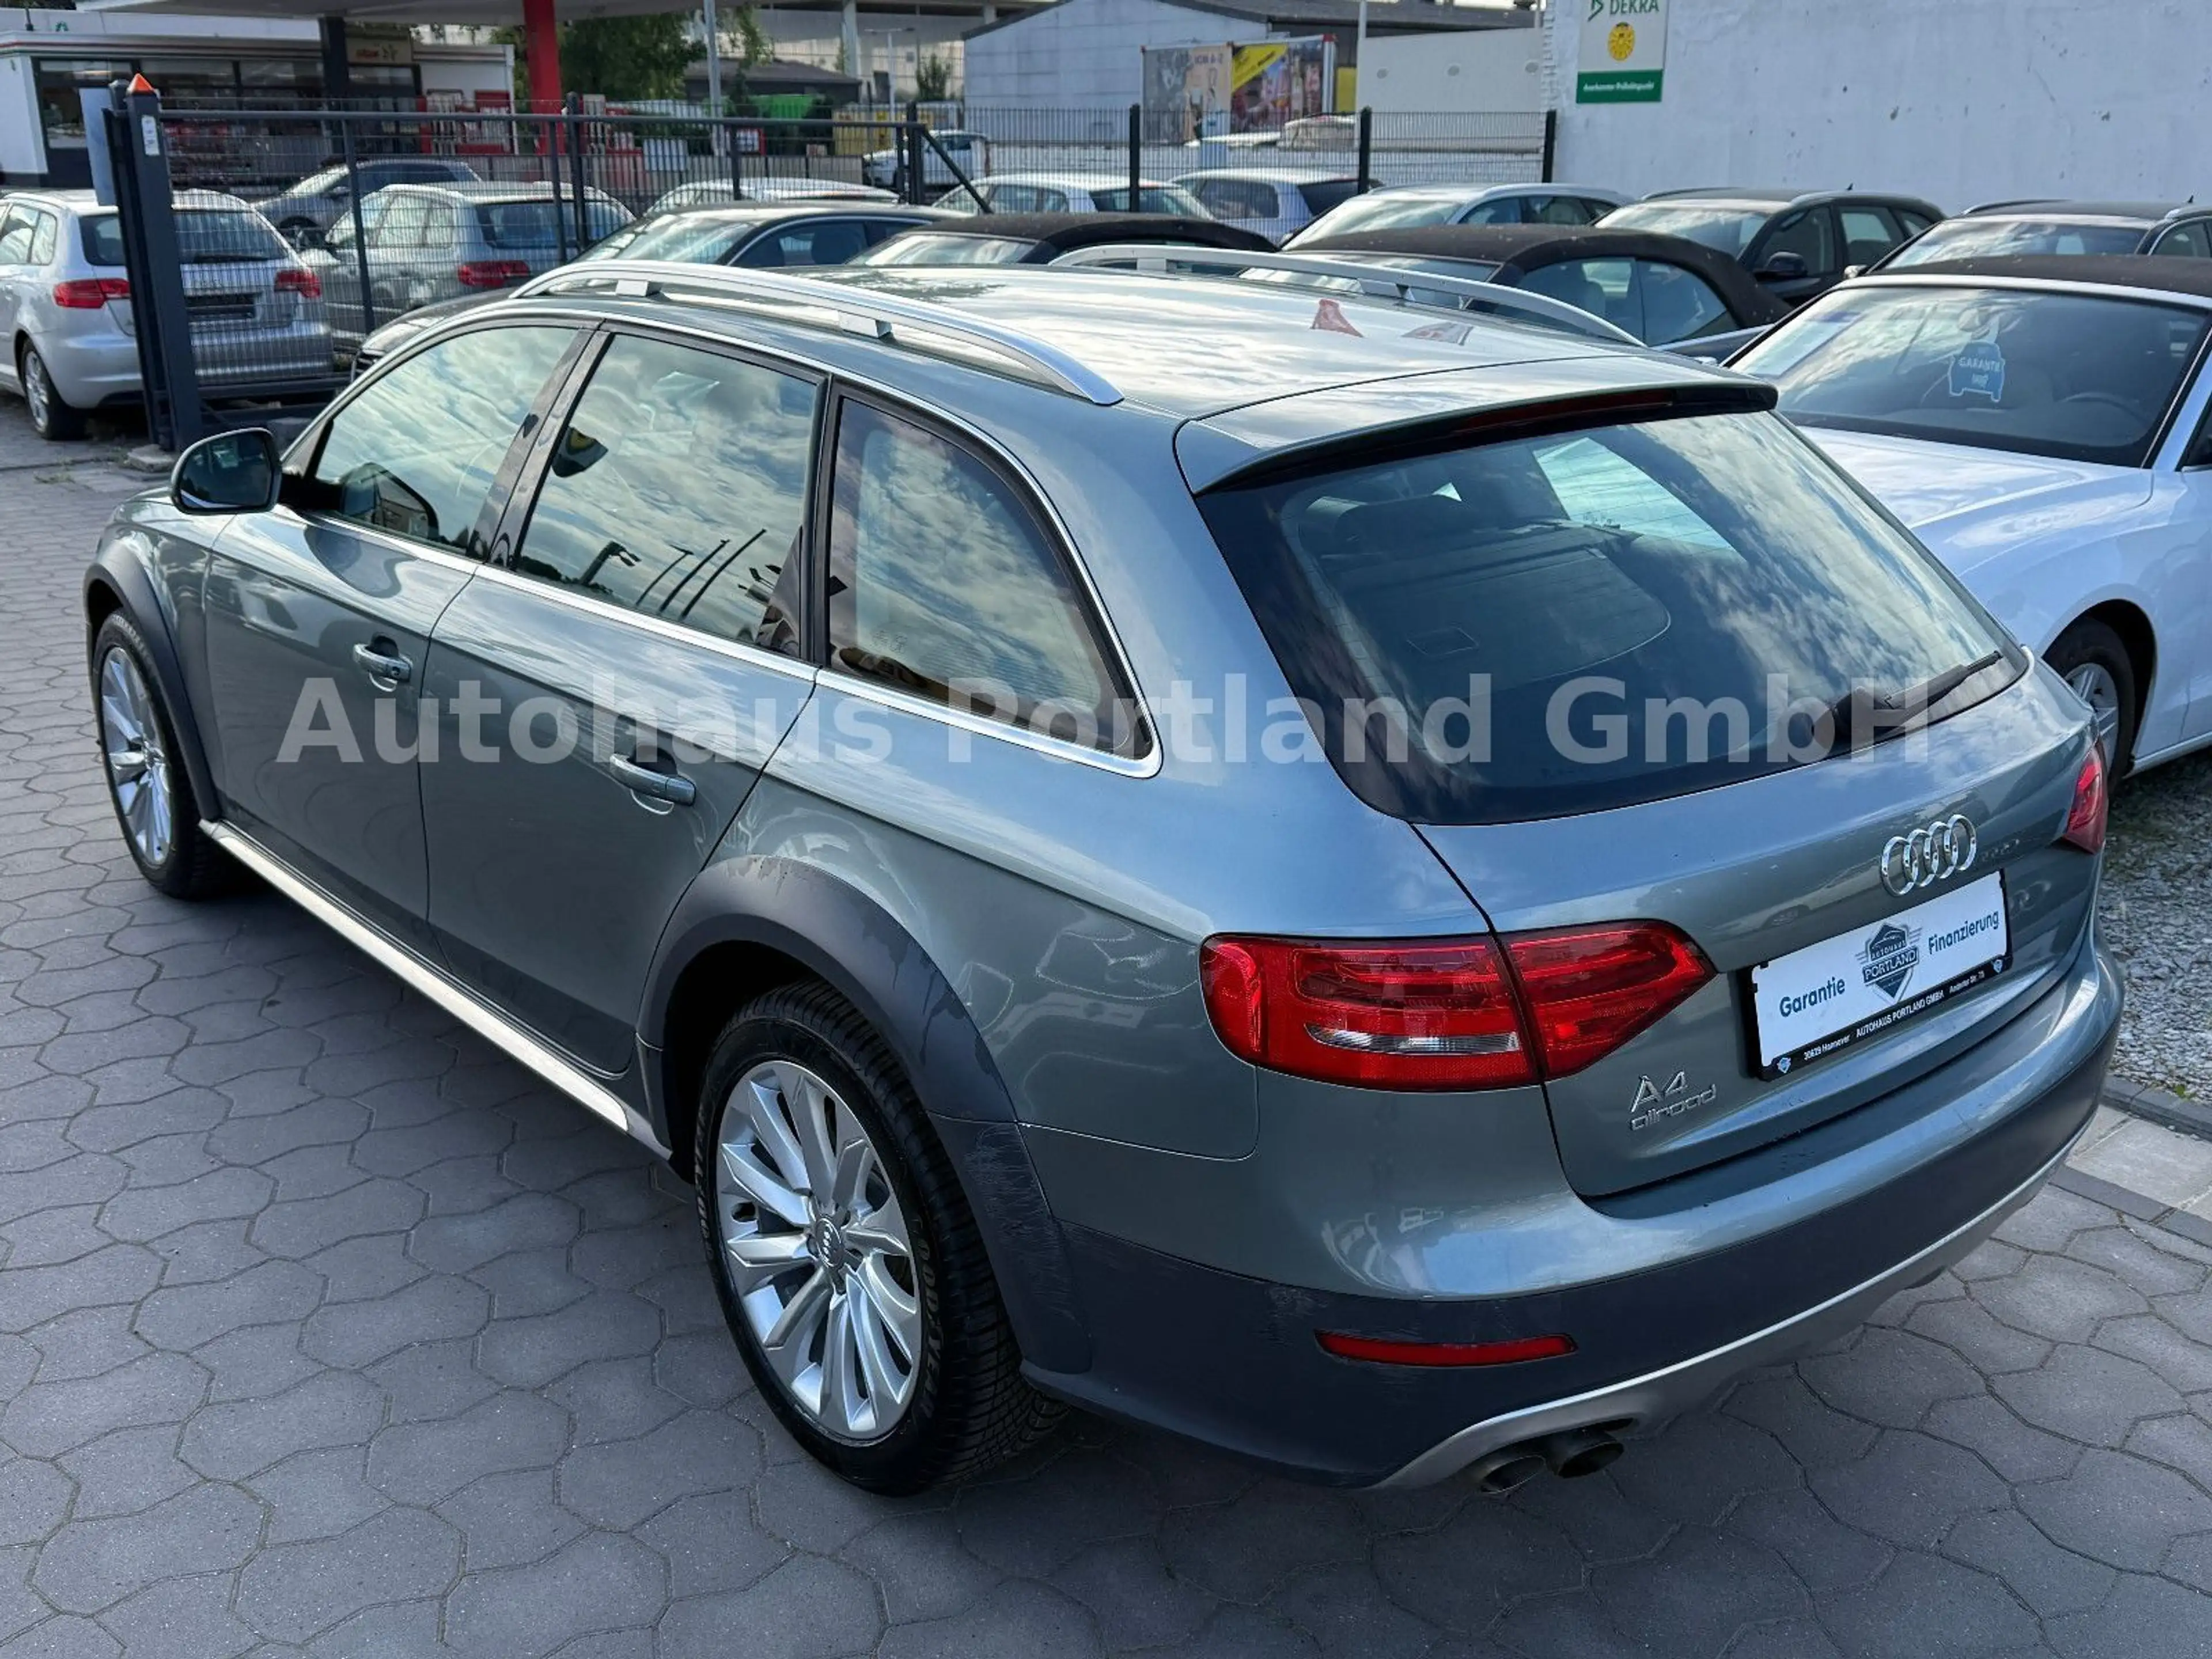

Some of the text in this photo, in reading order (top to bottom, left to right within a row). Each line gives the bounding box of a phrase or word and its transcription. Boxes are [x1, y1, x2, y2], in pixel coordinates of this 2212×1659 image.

[1610, 0, 1660, 14] DEKRA
[1928, 910, 1999, 955] Finanzierung
[1865, 949, 1915, 980] PORTLAND
[1779, 977, 1845, 1018] Garantie
[1856, 1014, 1892, 1037] AUTOHAUS
[1892, 999, 1926, 1021] PORTLAND
[1631, 1071, 1688, 1112] A4
[1631, 1084, 1717, 1131] allroad
